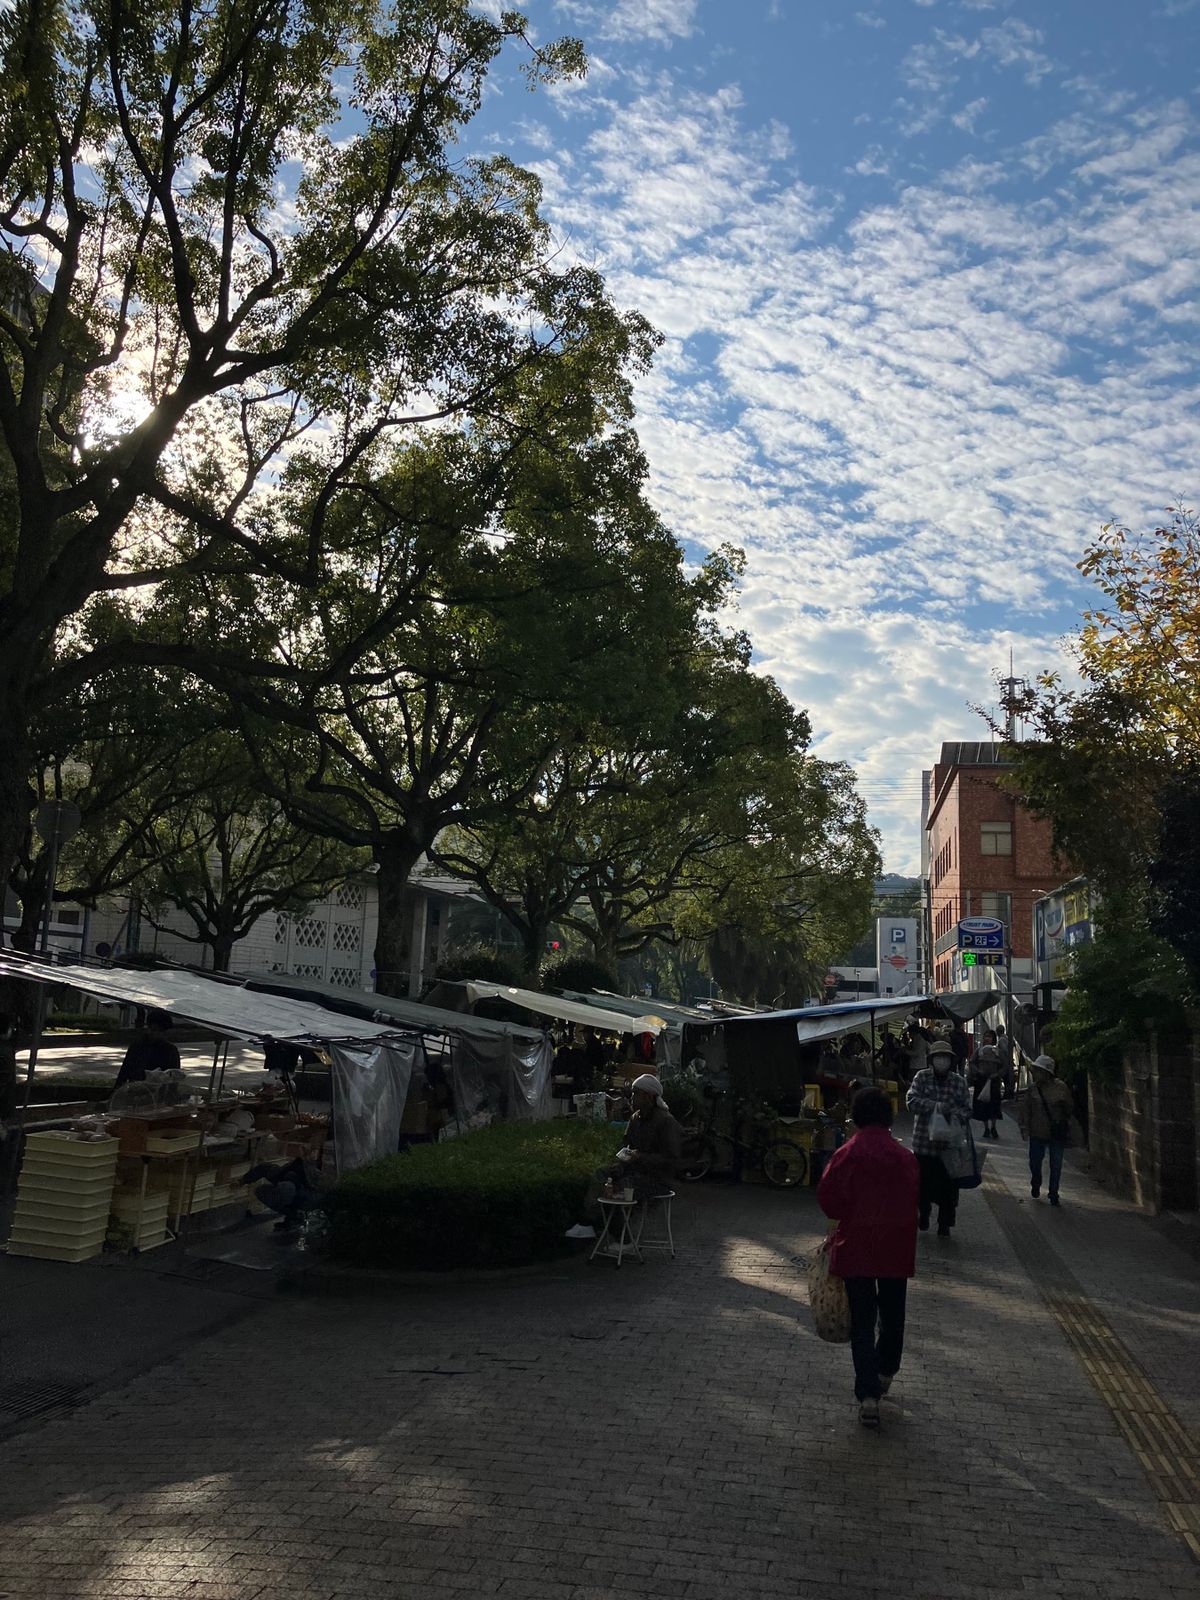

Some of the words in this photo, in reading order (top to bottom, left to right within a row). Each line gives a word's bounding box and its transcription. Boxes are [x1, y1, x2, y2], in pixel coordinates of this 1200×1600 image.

[892, 929, 905, 942] P
[962, 934, 973, 947] P
[976, 936, 986, 945] 2F
[984, 954, 1000, 965] 1F
